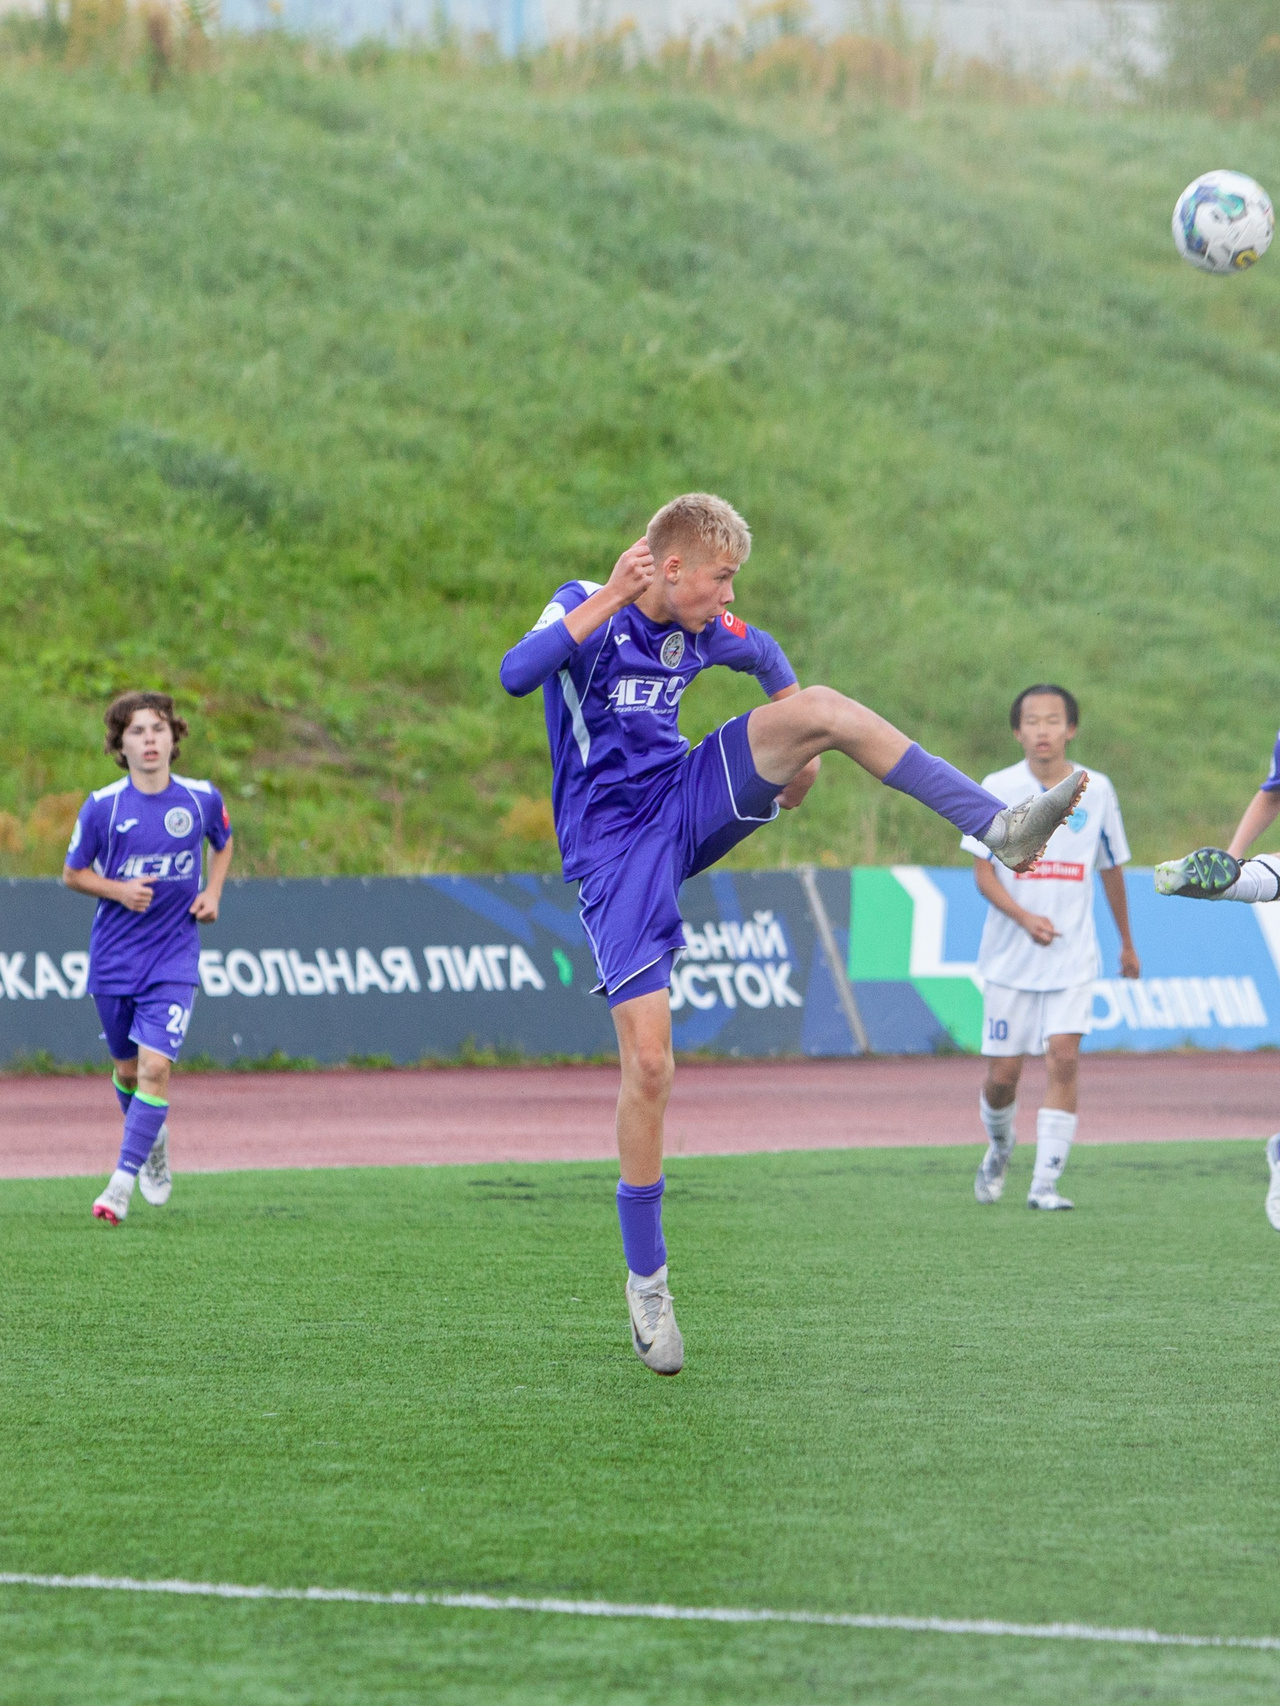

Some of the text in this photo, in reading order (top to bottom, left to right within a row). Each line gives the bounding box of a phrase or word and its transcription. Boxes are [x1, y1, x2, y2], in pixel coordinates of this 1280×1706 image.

[681, 909, 789, 961] ЬНИЙ
[0, 950, 90, 1000] КАЯ
[198, 944, 547, 997] БОЛЬНАЯ ЛИГА
[988, 1017, 1008, 1041] 10
